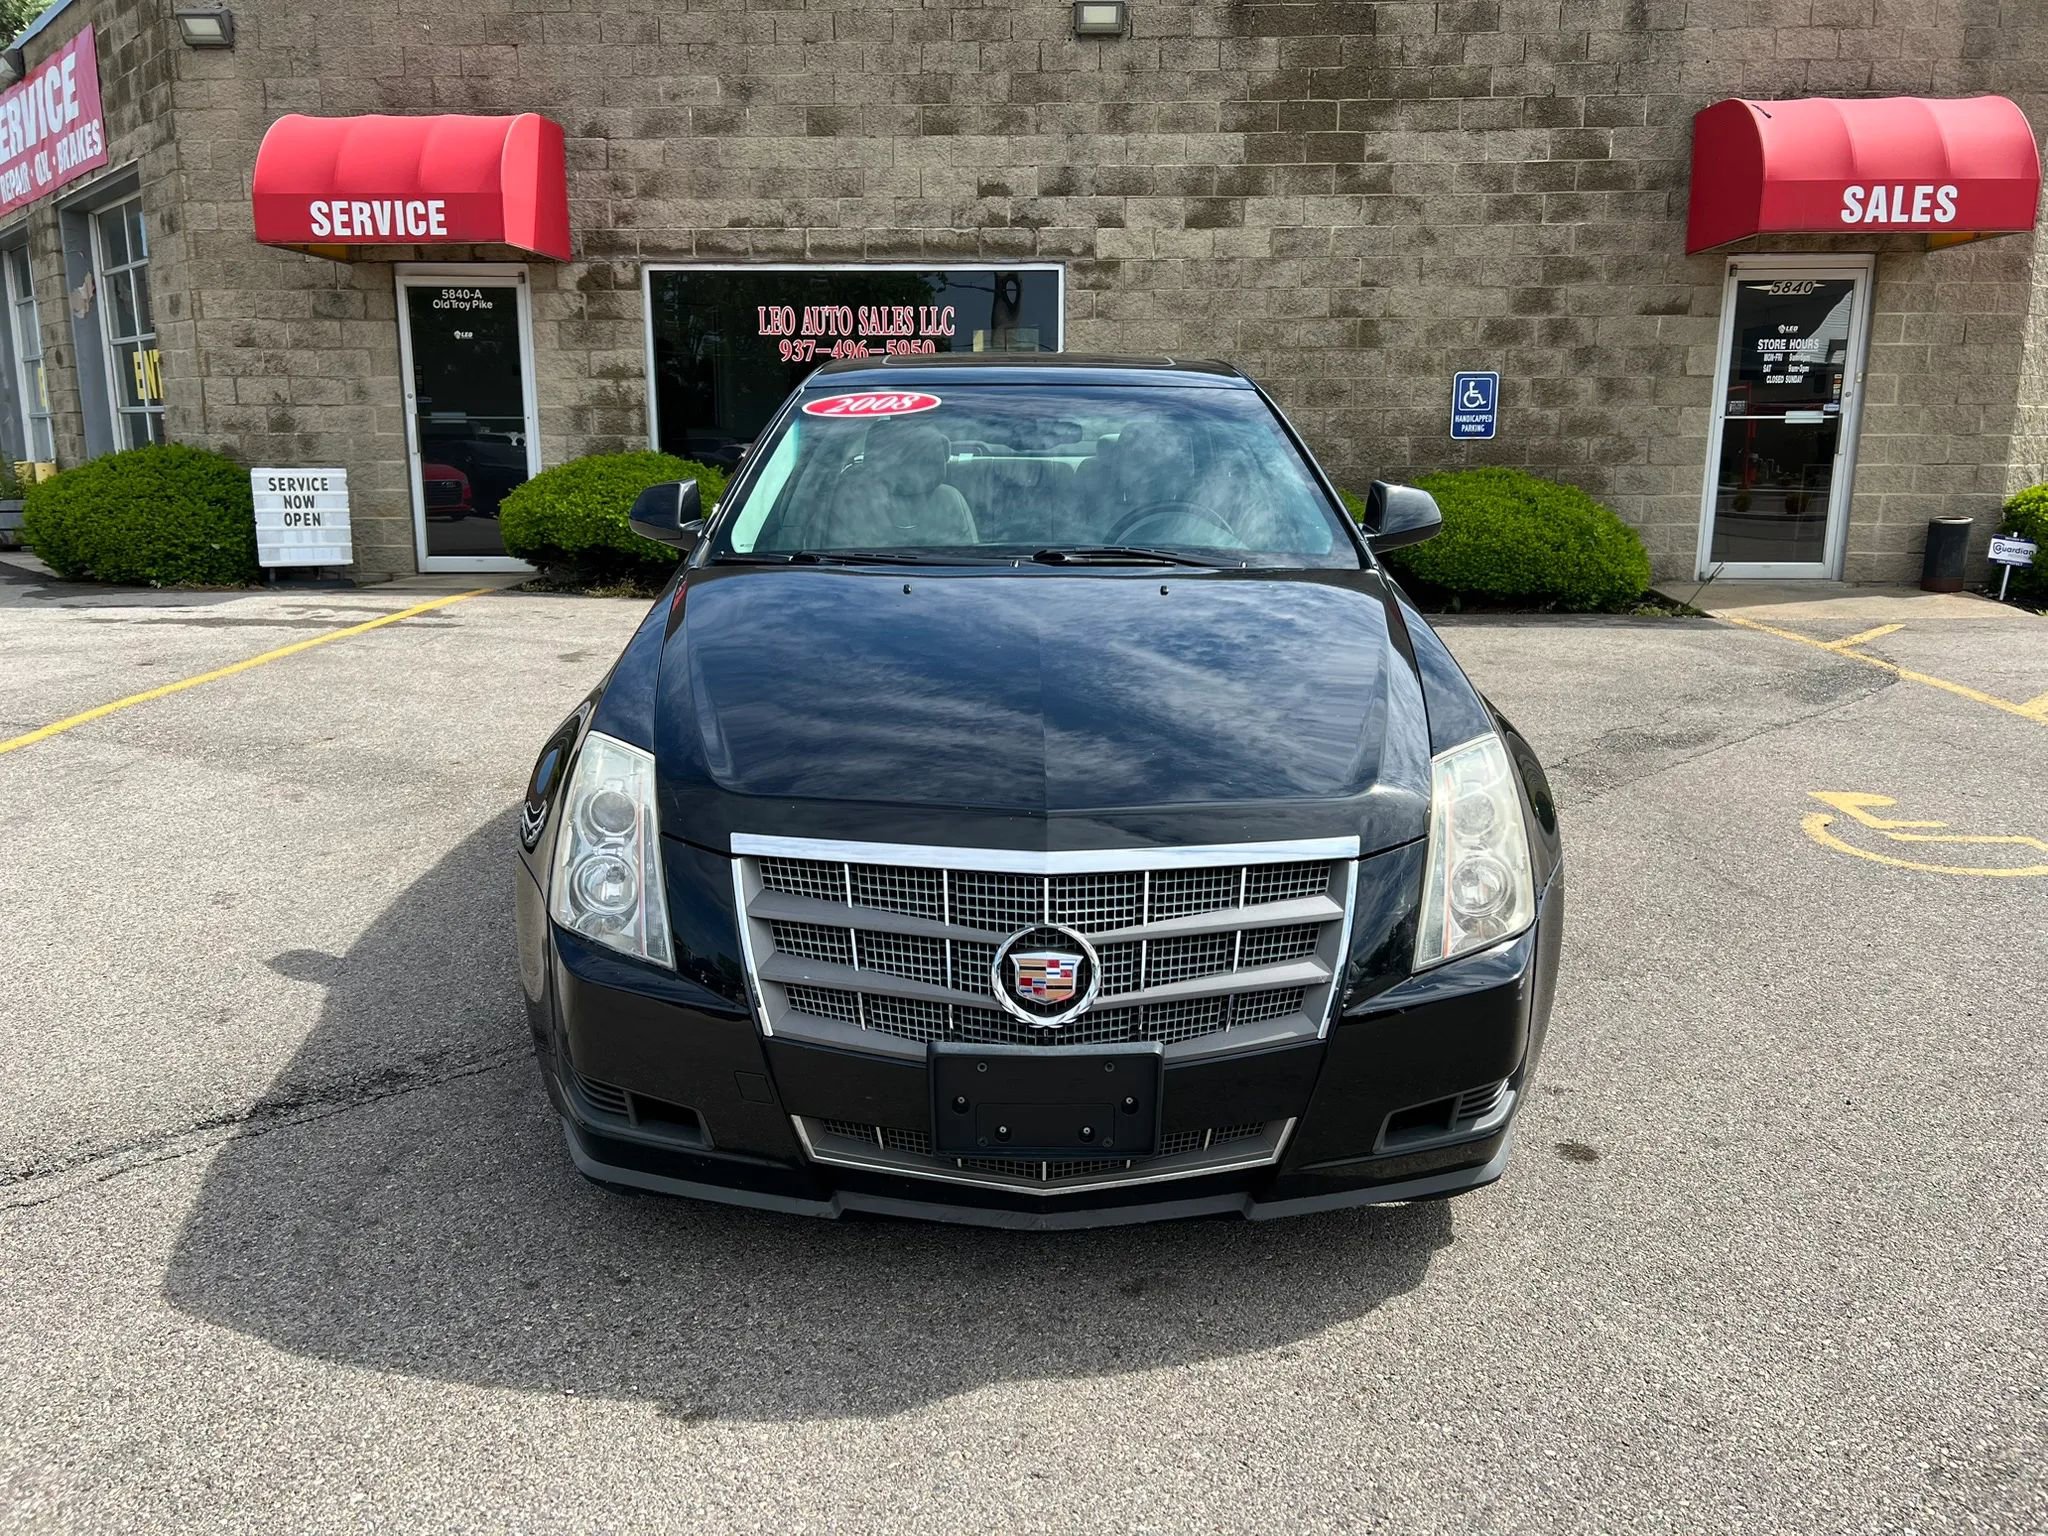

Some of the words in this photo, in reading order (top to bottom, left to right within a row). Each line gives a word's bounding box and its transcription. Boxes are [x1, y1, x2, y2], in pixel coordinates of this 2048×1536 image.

[34, 150, 52, 186] OIL
[56, 119, 102, 175] BRAKES
[1841, 185, 1958, 223] SALES
[310, 200, 447, 236] SERVICE
[441, 289, 482, 299] 5840-A
[1771, 281, 1814, 294] 5840
[432, 300, 450, 309] Old
[450, 300, 470, 311] Troy
[472, 300, 493, 309] Pike
[758, 306, 796, 336] LEO
[801, 306, 853, 336] AUTO
[858, 306, 914, 336] SALES
[919, 306, 955, 336] LLC
[1757, 339, 1787, 350] STORE
[1789, 339, 1819, 350] HOURS
[1762, 364, 1772, 372] SAT
[1766, 375, 1784, 383] CLOSED
[1785, 375, 1803, 383] SUNDAY
[824, 395, 920, 413] 2008
[1455, 414, 1493, 423] HANDICAPPED
[1461, 424, 1485, 432] PARKING
[268, 477, 329, 491] SERVICE
[283, 495, 315, 509] NOW
[284, 512, 321, 526] OPEN
[1993, 541, 2034, 556] Guardian
